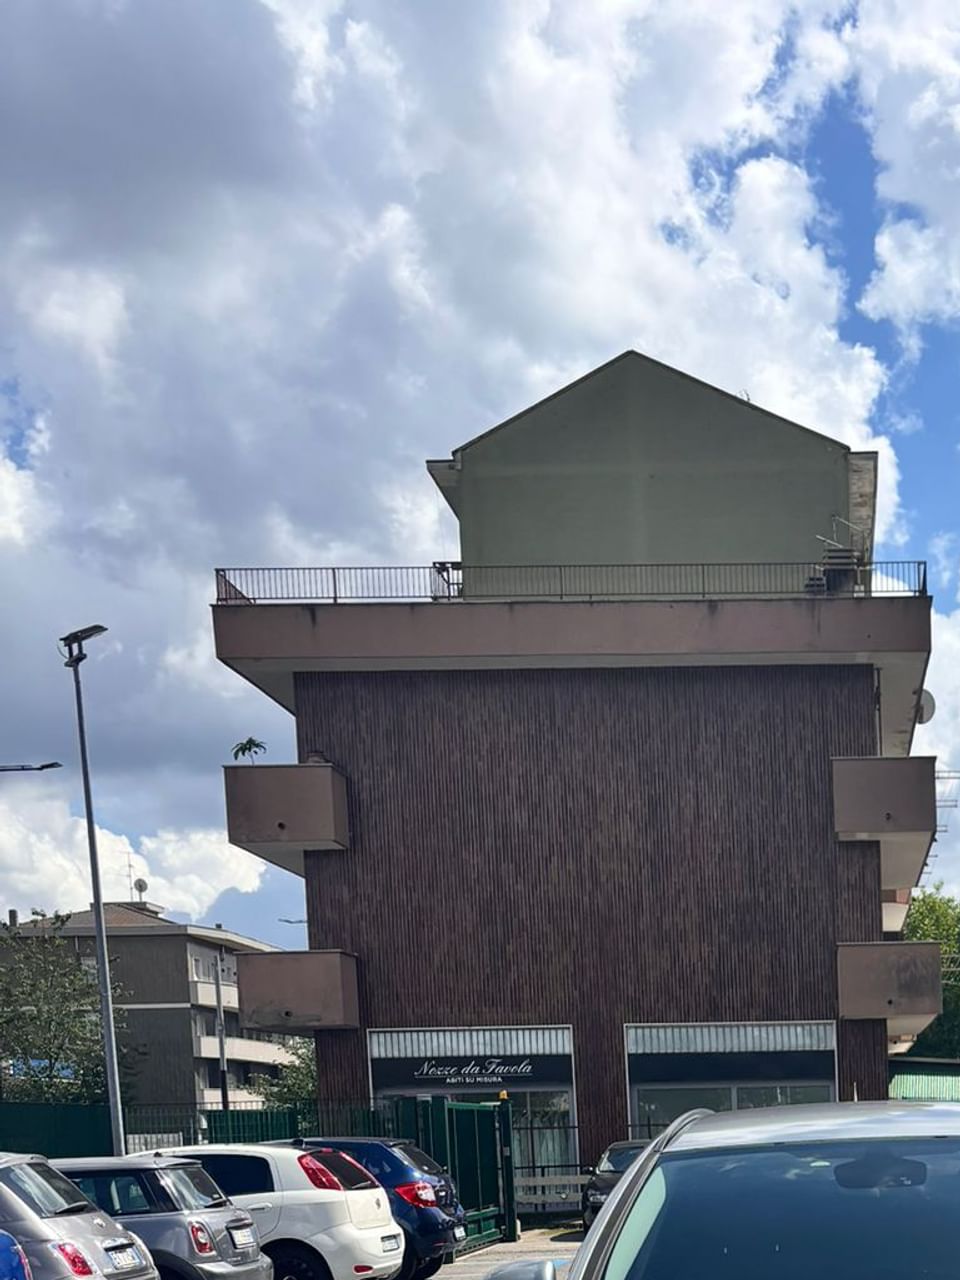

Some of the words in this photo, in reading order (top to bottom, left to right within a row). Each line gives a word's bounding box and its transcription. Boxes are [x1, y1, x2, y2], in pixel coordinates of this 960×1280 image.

[413, 1059, 458, 1075] Nozze
[461, 1060, 480, 1074] da
[482, 1058, 533, 1074] Favola
